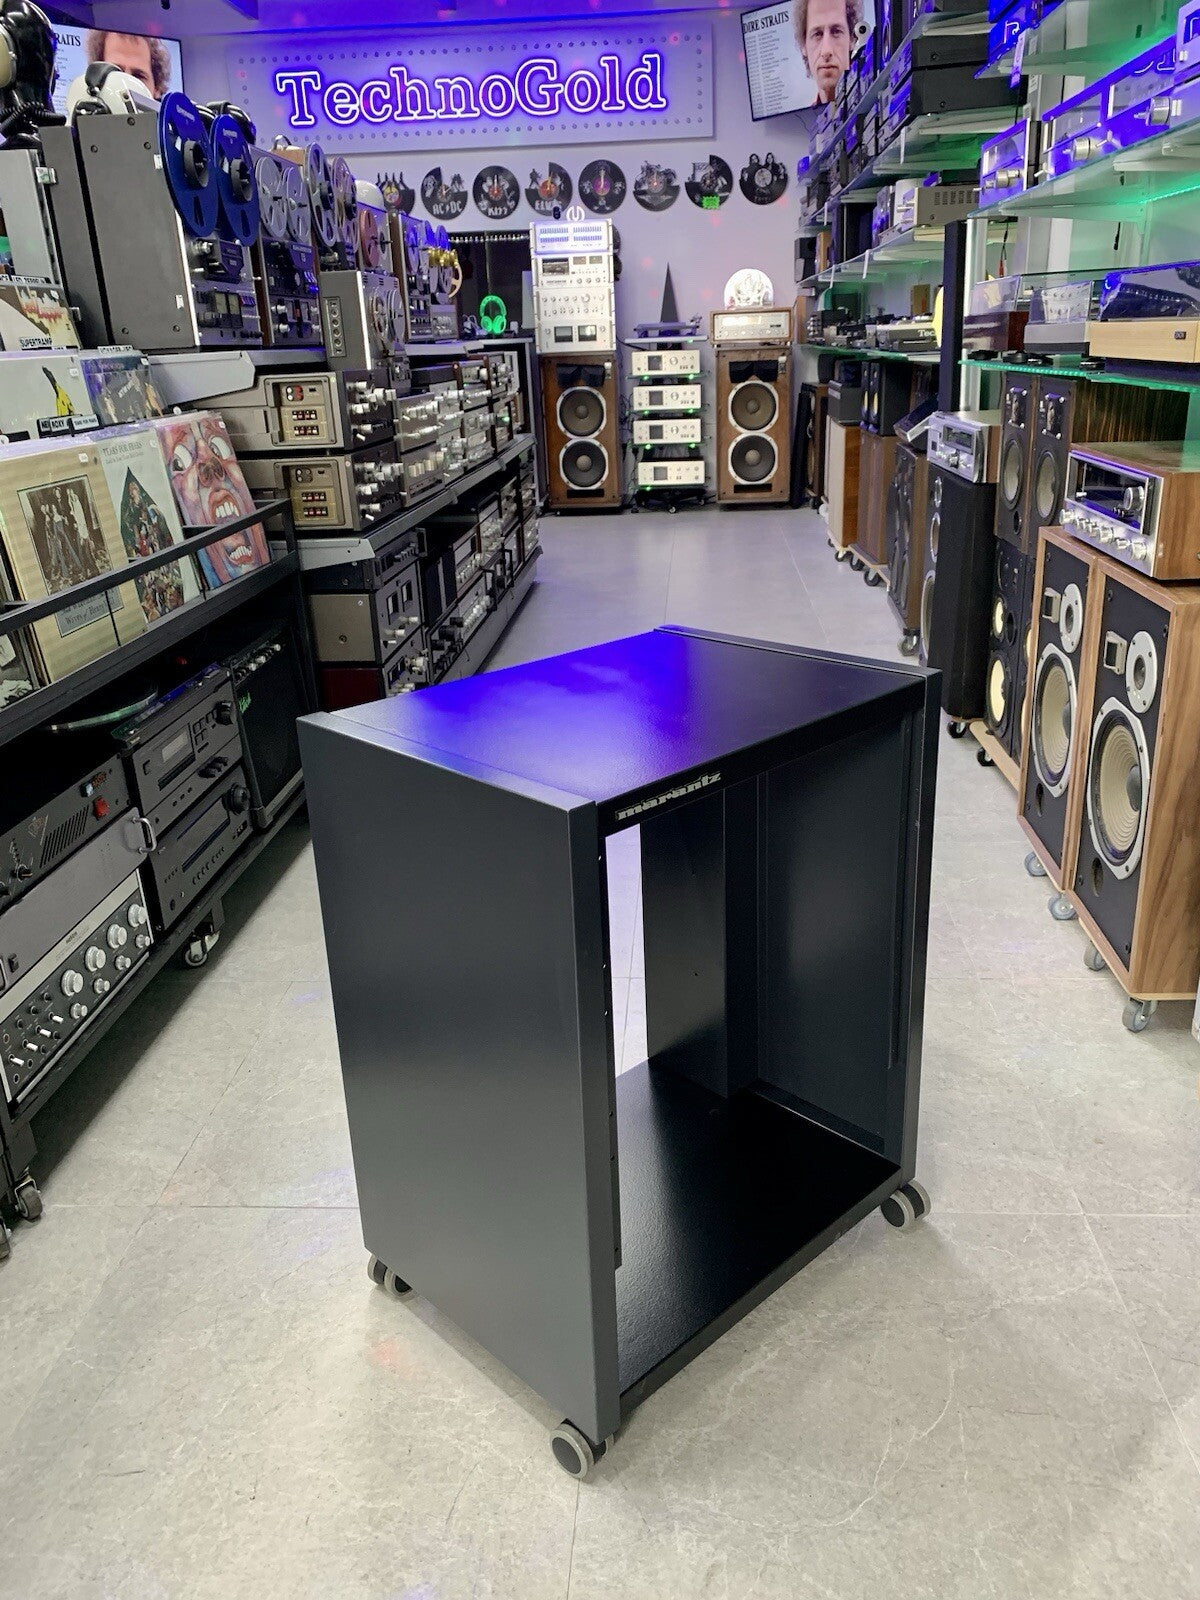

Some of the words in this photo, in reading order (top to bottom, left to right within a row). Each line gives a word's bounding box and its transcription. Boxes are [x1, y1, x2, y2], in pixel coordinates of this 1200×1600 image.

[761, 11, 789, 29] STRAITS
[276, 53, 667, 126] TechnoGold
[615, 771, 721, 821] marantz
